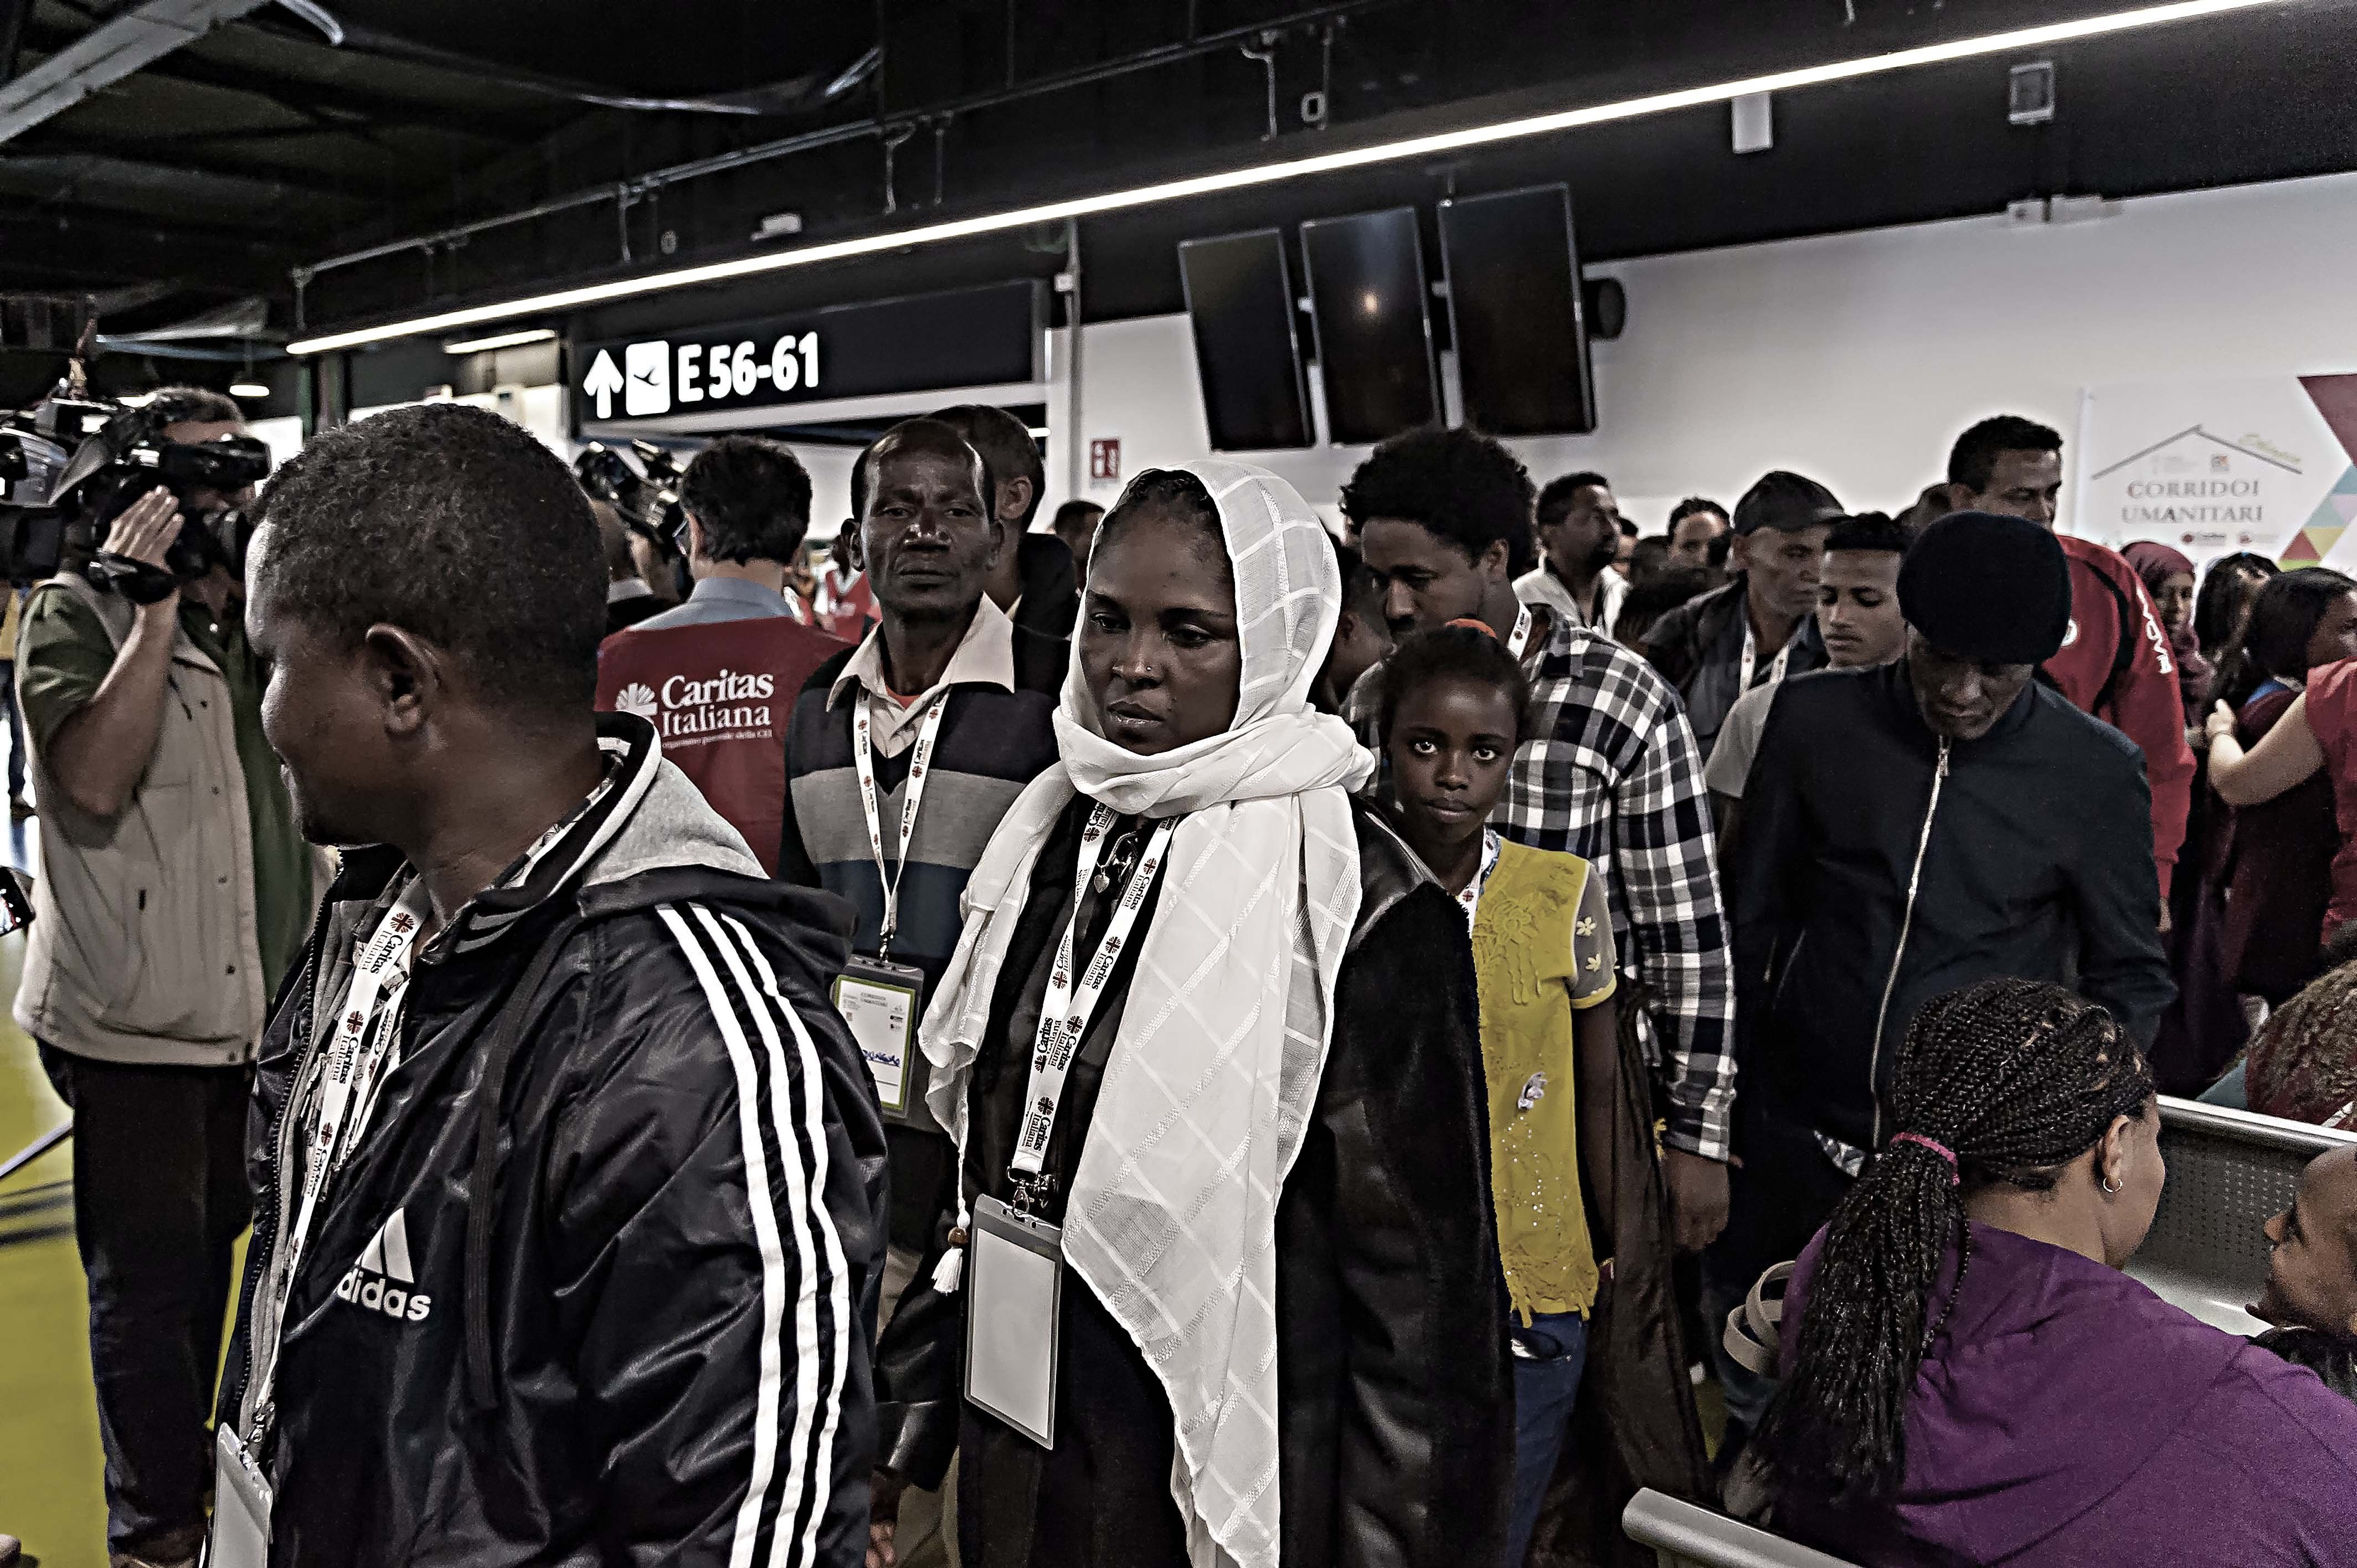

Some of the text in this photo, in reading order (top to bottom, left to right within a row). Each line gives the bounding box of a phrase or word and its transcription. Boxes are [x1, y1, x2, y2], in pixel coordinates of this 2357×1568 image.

[678, 331, 819, 403] E 56-61
[2127, 479, 2260, 498] CORRIDOI
[2121, 505, 2264, 523] UMANITARI
[661, 669, 775, 710] Caritas
[661, 705, 772, 737] Italiana
[1124, 875, 1144, 907] Italiana
[1130, 876, 1150, 910] Caritas
[362, 930, 392, 970] Italiana
[370, 935, 404, 974] Caritas
[1085, 953, 1107, 986] Italiana
[1092, 956, 1114, 990] Caritas
[1037, 1017, 1053, 1053] Caritas
[1051, 1032, 1069, 1067] Italiana
[332, 1035, 351, 1081] Italiana
[339, 1036, 359, 1085] Caritas
[1057, 1036, 1077, 1071] Caritas
[1025, 1113, 1042, 1148] Italiana
[1033, 1117, 1051, 1151] Caritas
[333, 1267, 431, 1321] didas
